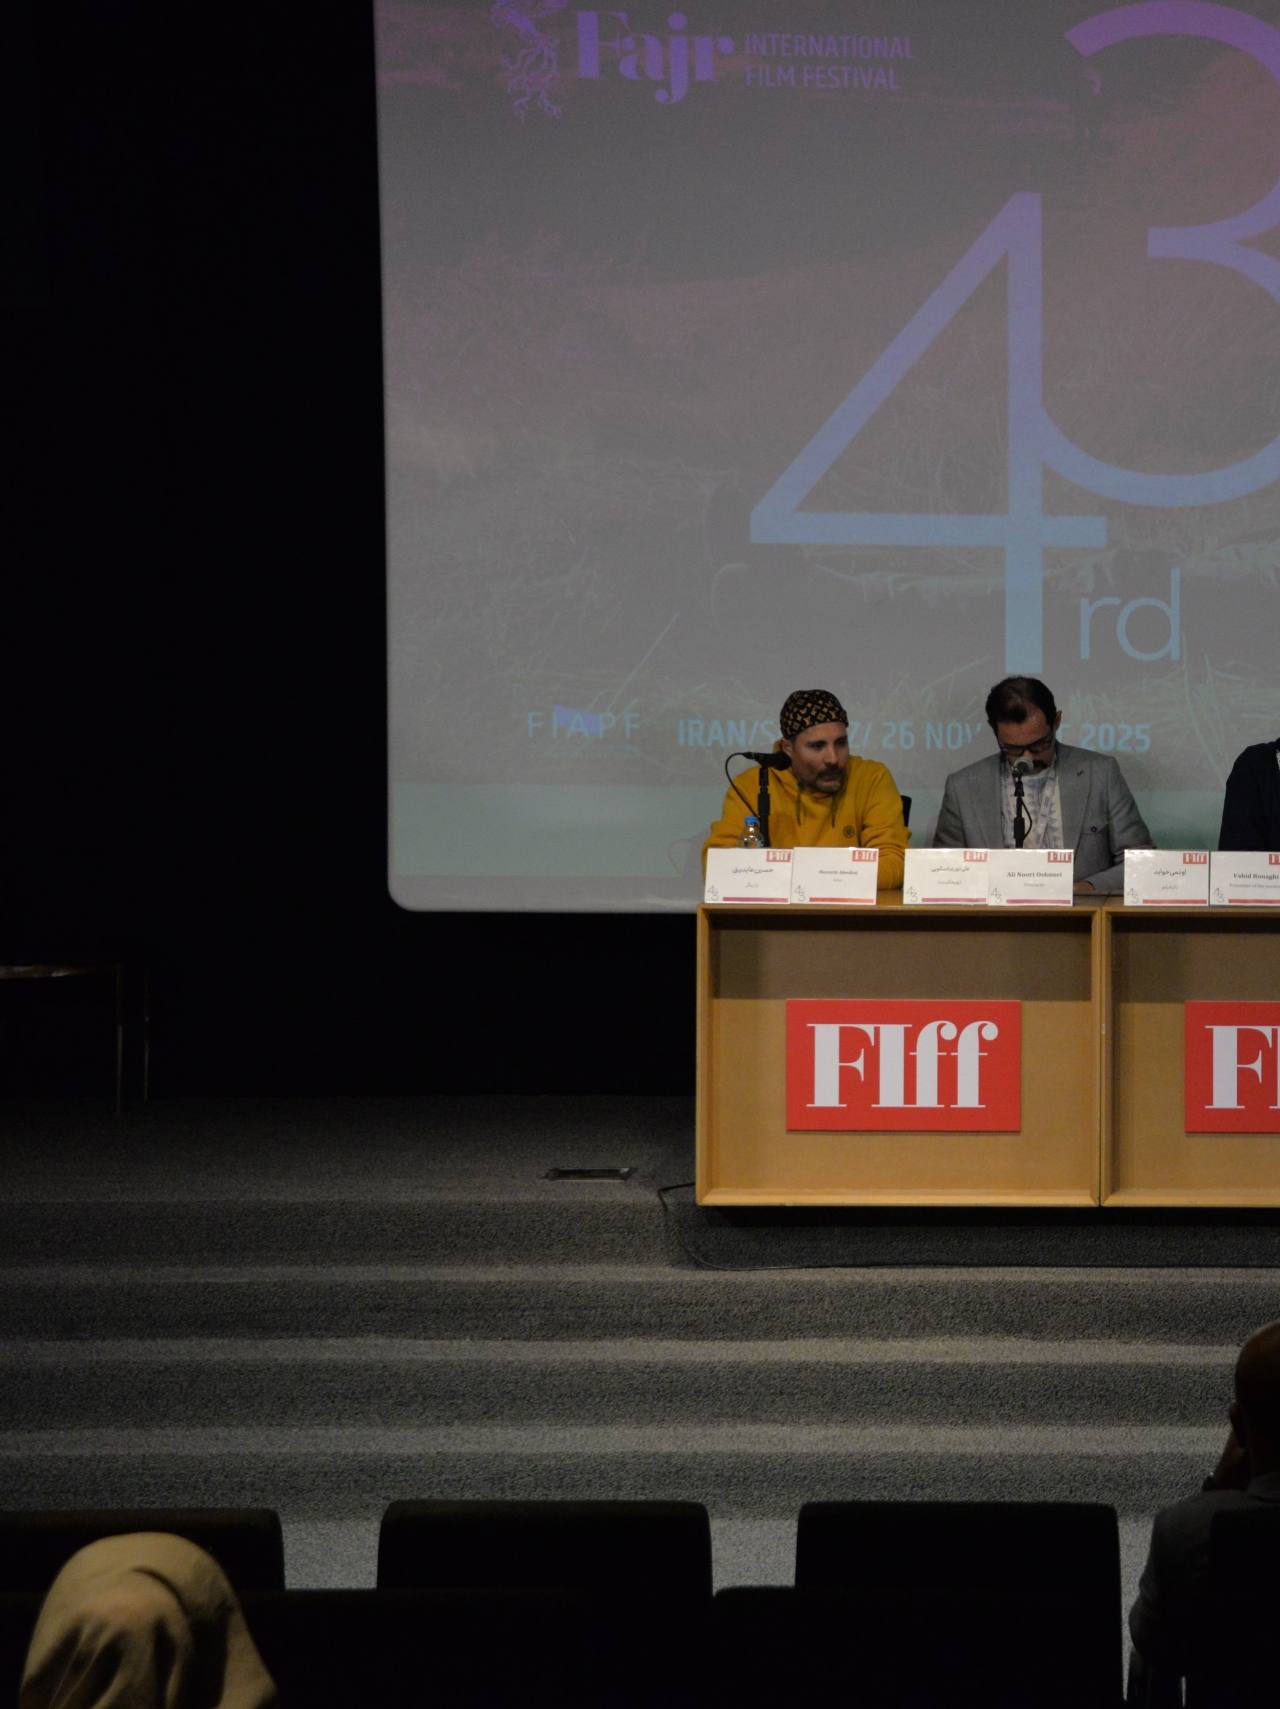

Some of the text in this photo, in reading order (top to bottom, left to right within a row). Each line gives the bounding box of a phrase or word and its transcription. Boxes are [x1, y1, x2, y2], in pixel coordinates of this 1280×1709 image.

[576, 11, 736, 104] Fajr
[744, 32, 916, 61] INTERNATIONAL
[744, 64, 901, 90] FILM FESTIVAL
[881, 720, 918, 750] 26
[1080, 721, 1152, 753] 2025
[806, 1019, 999, 1109] FIff
